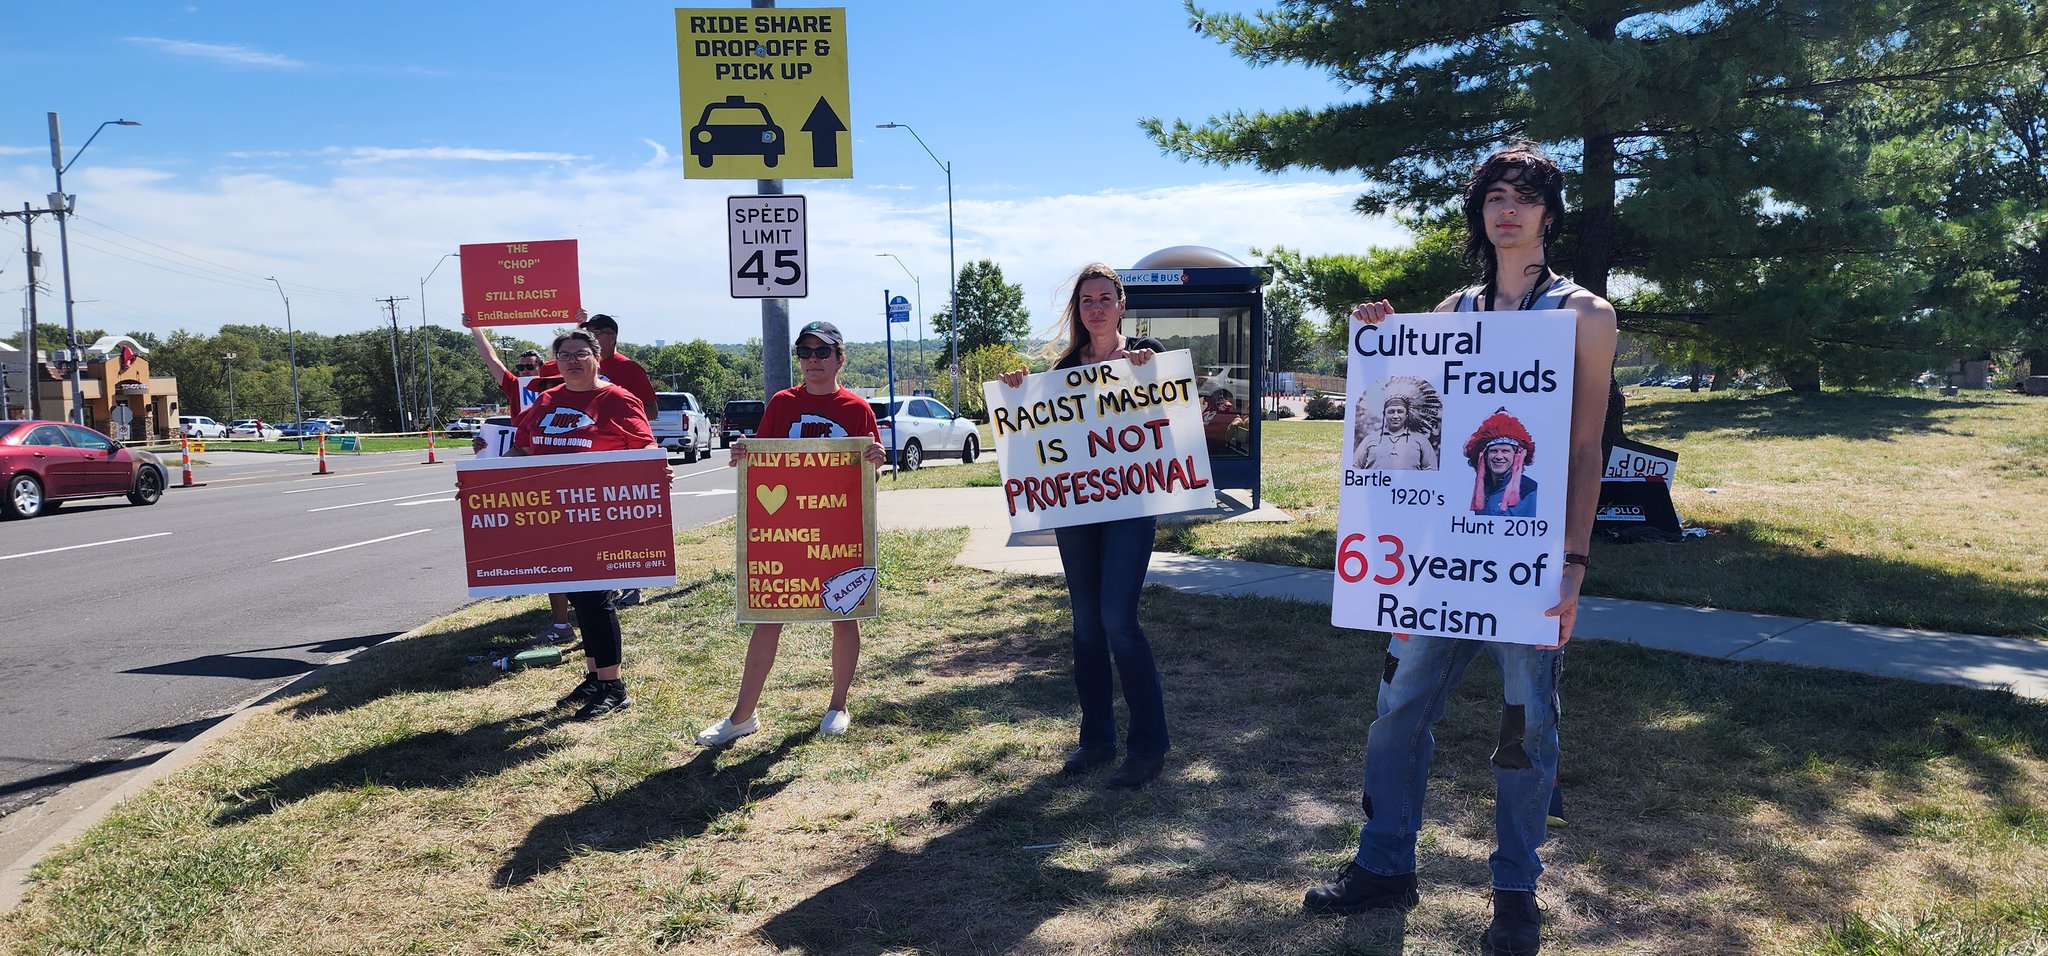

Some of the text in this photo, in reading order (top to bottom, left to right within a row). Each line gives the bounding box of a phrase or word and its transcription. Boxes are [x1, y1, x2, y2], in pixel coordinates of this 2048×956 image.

[690, 16, 832, 33] RIDE SHARE
[695, 39, 830, 57] DROP OFF &
[716, 63, 813, 80] PICK UP
[735, 208, 799, 224] SPEED
[742, 229, 792, 245] LIMIT
[506, 243, 529, 254] THE
[498, 259, 540, 269] "CHOP"
[737, 250, 802, 286] 45
[513, 275, 525, 285] IS
[1160, 273, 1180, 282] BUS
[485, 289, 558, 302] STILL RACIST
[477, 308, 569, 321] EndRacismKC.org
[1354, 321, 1482, 357] Cultural
[1066, 365, 1119, 387] OUR
[1443, 360, 1557, 395] Frauds
[994, 378, 1192, 436] RACIST MASCOT
[550, 413, 583, 429] NOPE
[800, 422, 834, 438] NOPE
[532, 436, 593, 449] NOT IN OUR HONOR
[1036, 418, 1170, 466] IS NOT
[748, 453, 782, 468] ALLY
[785, 453, 801, 467] IS
[803, 453, 816, 467] A
[1620, 454, 1668, 476] CHOP
[1004, 455, 1209, 516] PROFESSIONAL
[1345, 470, 1392, 487] Bartle
[468, 483, 661, 510] CHANGE THE NAME
[796, 493, 848, 510] TEAM
[1391, 488, 1445, 506] 1920's
[471, 504, 663, 529] AND STOP THE CHOP!
[1451, 516, 1548, 537] Hunt 2019
[748, 528, 821, 543] CHANGE
[596, 548, 666, 562] #EndRacism
[807, 543, 863, 561] NAME!
[1337, 533, 1549, 587] 63 years of
[476, 565, 573, 578] EndRacismKC.com
[606, 560, 667, 571] @CHIEFS @NFL
[748, 560, 784, 575] END
[750, 577, 821, 593] RACISM
[832, 573, 868, 602] RACIST
[750, 593, 820, 609] KC.COM
[1377, 593, 1497, 637] Racism
